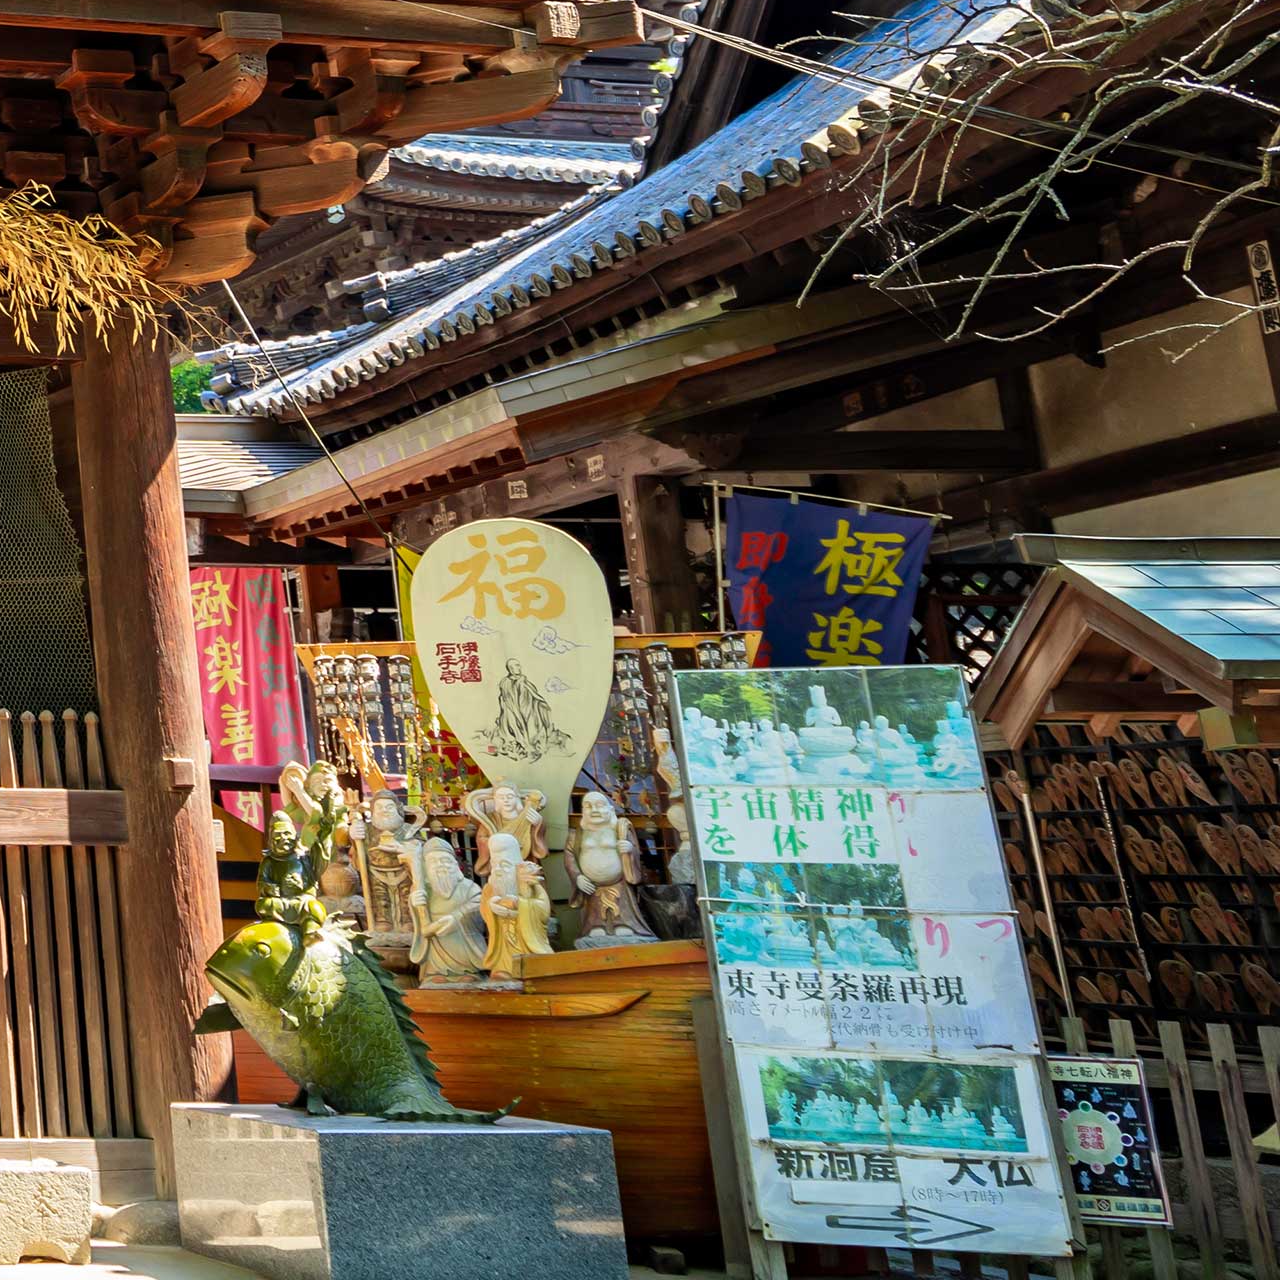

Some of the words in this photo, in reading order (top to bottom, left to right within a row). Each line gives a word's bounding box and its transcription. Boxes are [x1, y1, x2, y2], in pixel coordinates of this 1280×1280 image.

[437, 528, 566, 621] 福
[735, 531, 790, 668] 即身
[695, 787, 874, 822] 宇宙精神
[723, 969, 969, 1007] 東寺曼荼羅再現
[1048, 1065, 1134, 1080] 寺七転八福神
[942, 1156, 1035, 1188] 大仏
